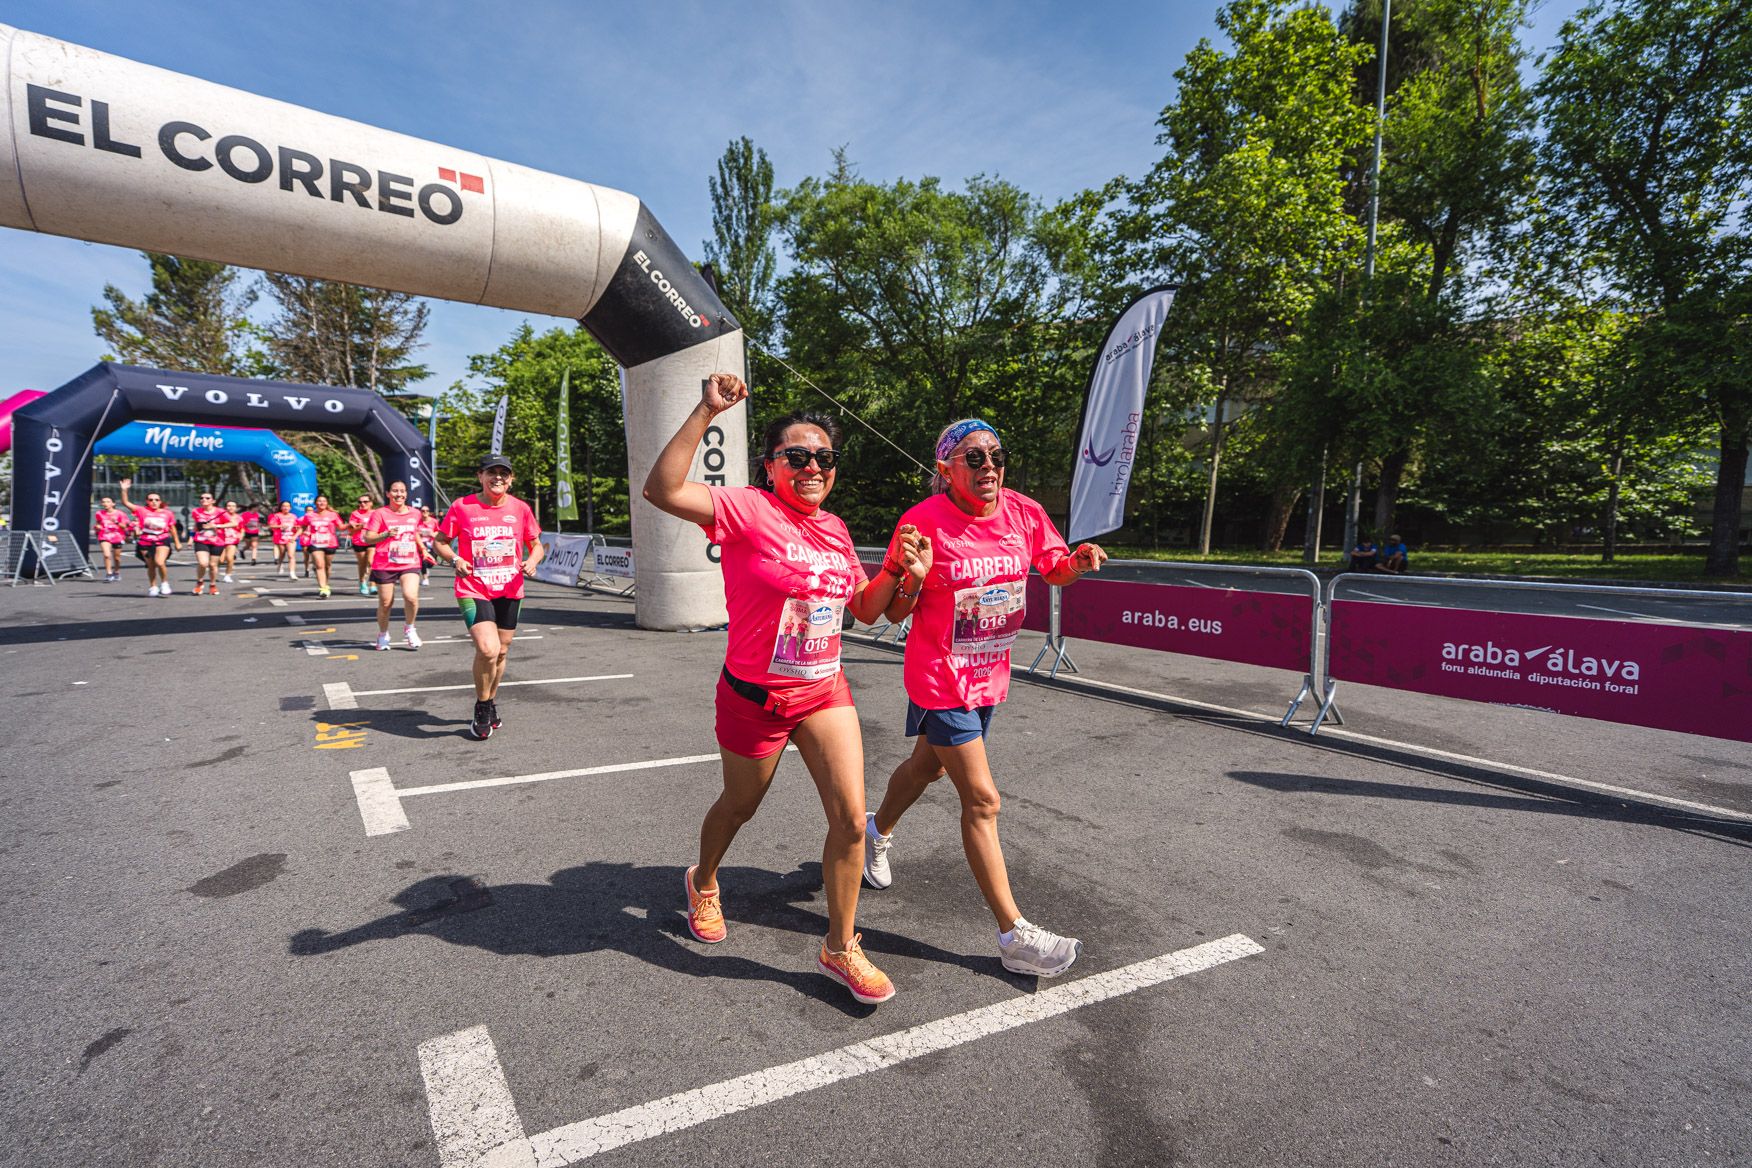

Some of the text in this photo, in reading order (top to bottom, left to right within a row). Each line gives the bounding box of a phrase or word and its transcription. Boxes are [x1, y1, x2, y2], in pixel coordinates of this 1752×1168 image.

[26, 82, 464, 226] EL CORREO
[633, 249, 702, 328] EL CORREO
[1105, 342, 1128, 361] araba
[1134, 324, 1155, 342] álava
[156, 384, 345, 413] VOLVO
[558, 381, 569, 474] AMUTIO
[1109, 412, 1140, 497] kirolaraba
[409, 456, 422, 508] LVO
[41, 437, 63, 559] VOLVO
[473, 526, 514, 537] CARRERA
[597, 554, 630, 568] EL CORREO
[950, 555, 1023, 581] CARRERA
[980, 615, 1007, 629] 016
[1122, 609, 1223, 635] araba.eus
[805, 637, 829, 652] 016
[779, 667, 807, 676] OYSHO
[974, 667, 992, 679] 2026
[1441, 641, 1640, 681] araba álava
[1441, 661, 1639, 695] foru aldundia diputación foral
